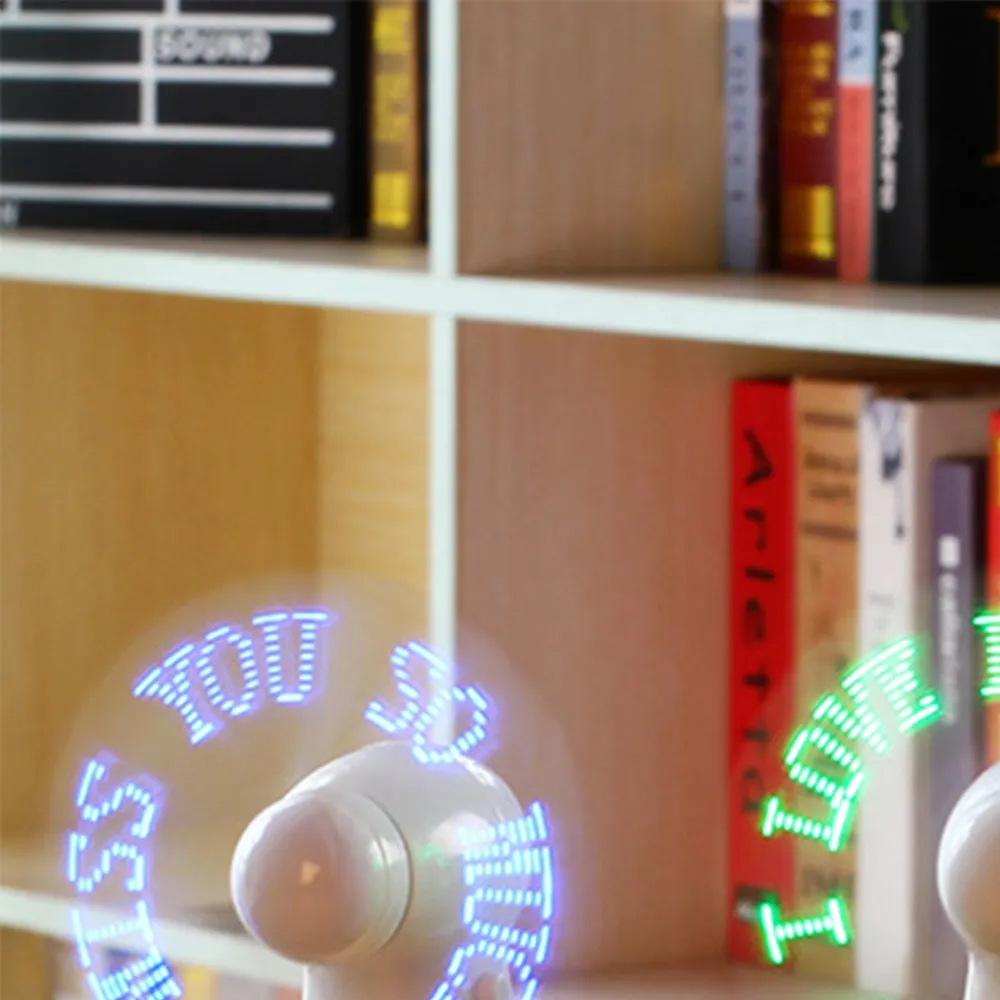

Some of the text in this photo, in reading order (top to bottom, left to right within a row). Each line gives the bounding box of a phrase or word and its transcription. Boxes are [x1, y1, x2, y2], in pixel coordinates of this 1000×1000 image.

[132, 611, 328, 745] YOU
[364, 640, 489, 764] SO
[762, 635, 942, 852] LOVE
[760, 896, 848, 965] I
